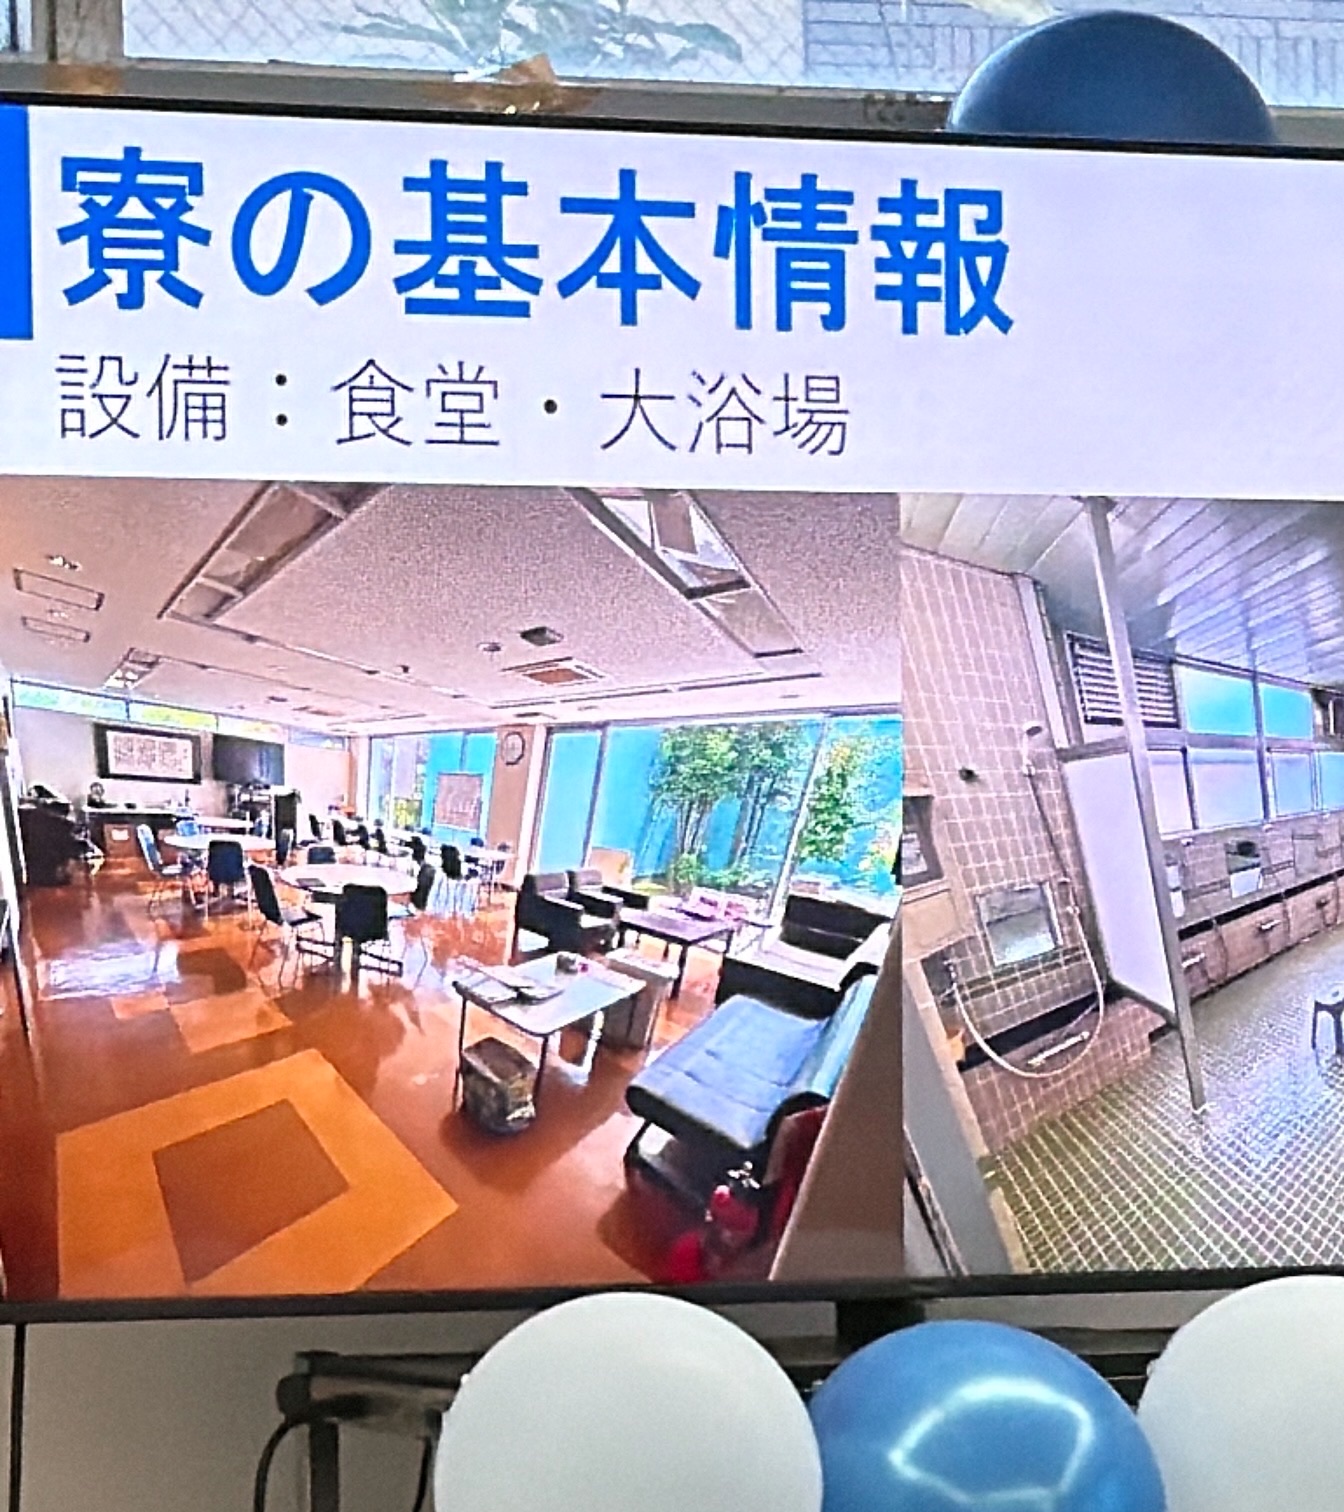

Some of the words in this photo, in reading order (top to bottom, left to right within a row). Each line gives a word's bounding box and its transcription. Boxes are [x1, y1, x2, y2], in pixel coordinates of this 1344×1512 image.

[56, 146, 1016, 337] 寮の基本情報
[54, 353, 850, 460] 設備：食堂・大浴場
